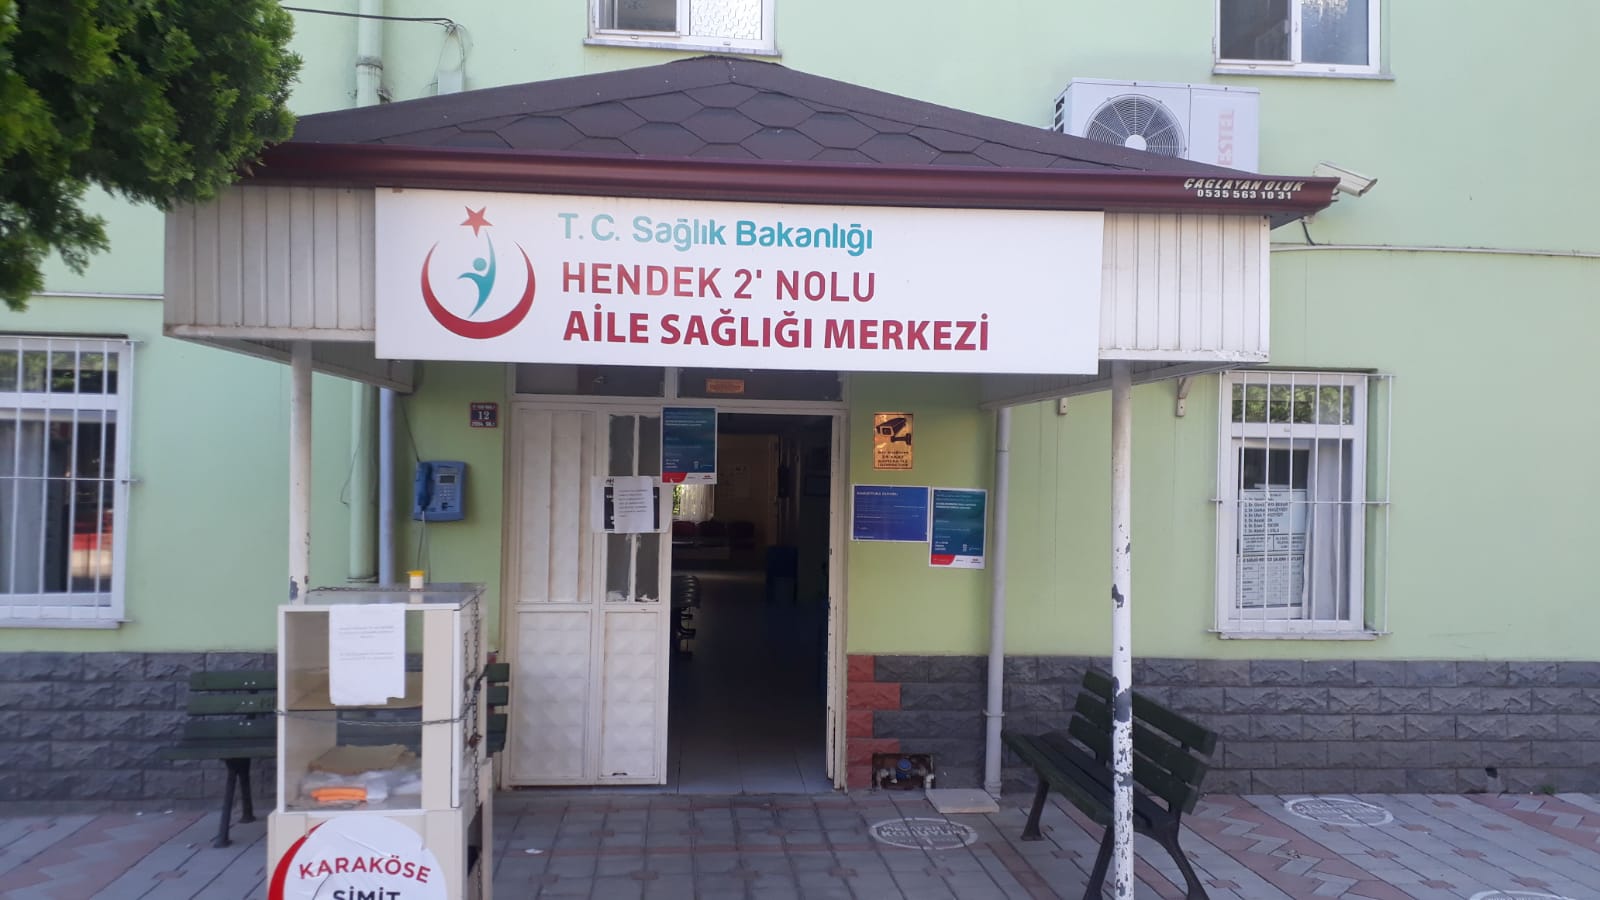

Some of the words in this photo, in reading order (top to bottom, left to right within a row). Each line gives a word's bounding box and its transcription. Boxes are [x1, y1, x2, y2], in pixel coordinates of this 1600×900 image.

[1217, 110, 1233, 167] ESTEL
[1197, 189, 1229, 198] 0535
[1233, 190, 1256, 198] 563
[1261, 191, 1274, 199] 10
[1278, 191, 1292, 199] 31
[1264, 181, 1304, 191] OLUK
[632, 215, 727, 252] Sağlık
[735, 219, 874, 257] Bakanlığı
[562, 262, 721, 298] HENDEK
[776, 270, 876, 302] NOLU
[563, 304, 650, 344] AİLE
[660, 308, 813, 348] SAĞLIĞI
[824, 313, 990, 351] MERKEZİ
[478, 411, 490, 420] 12
[299, 854, 431, 883] KARAKÖSE
[333, 886, 401, 900] SİMİT
